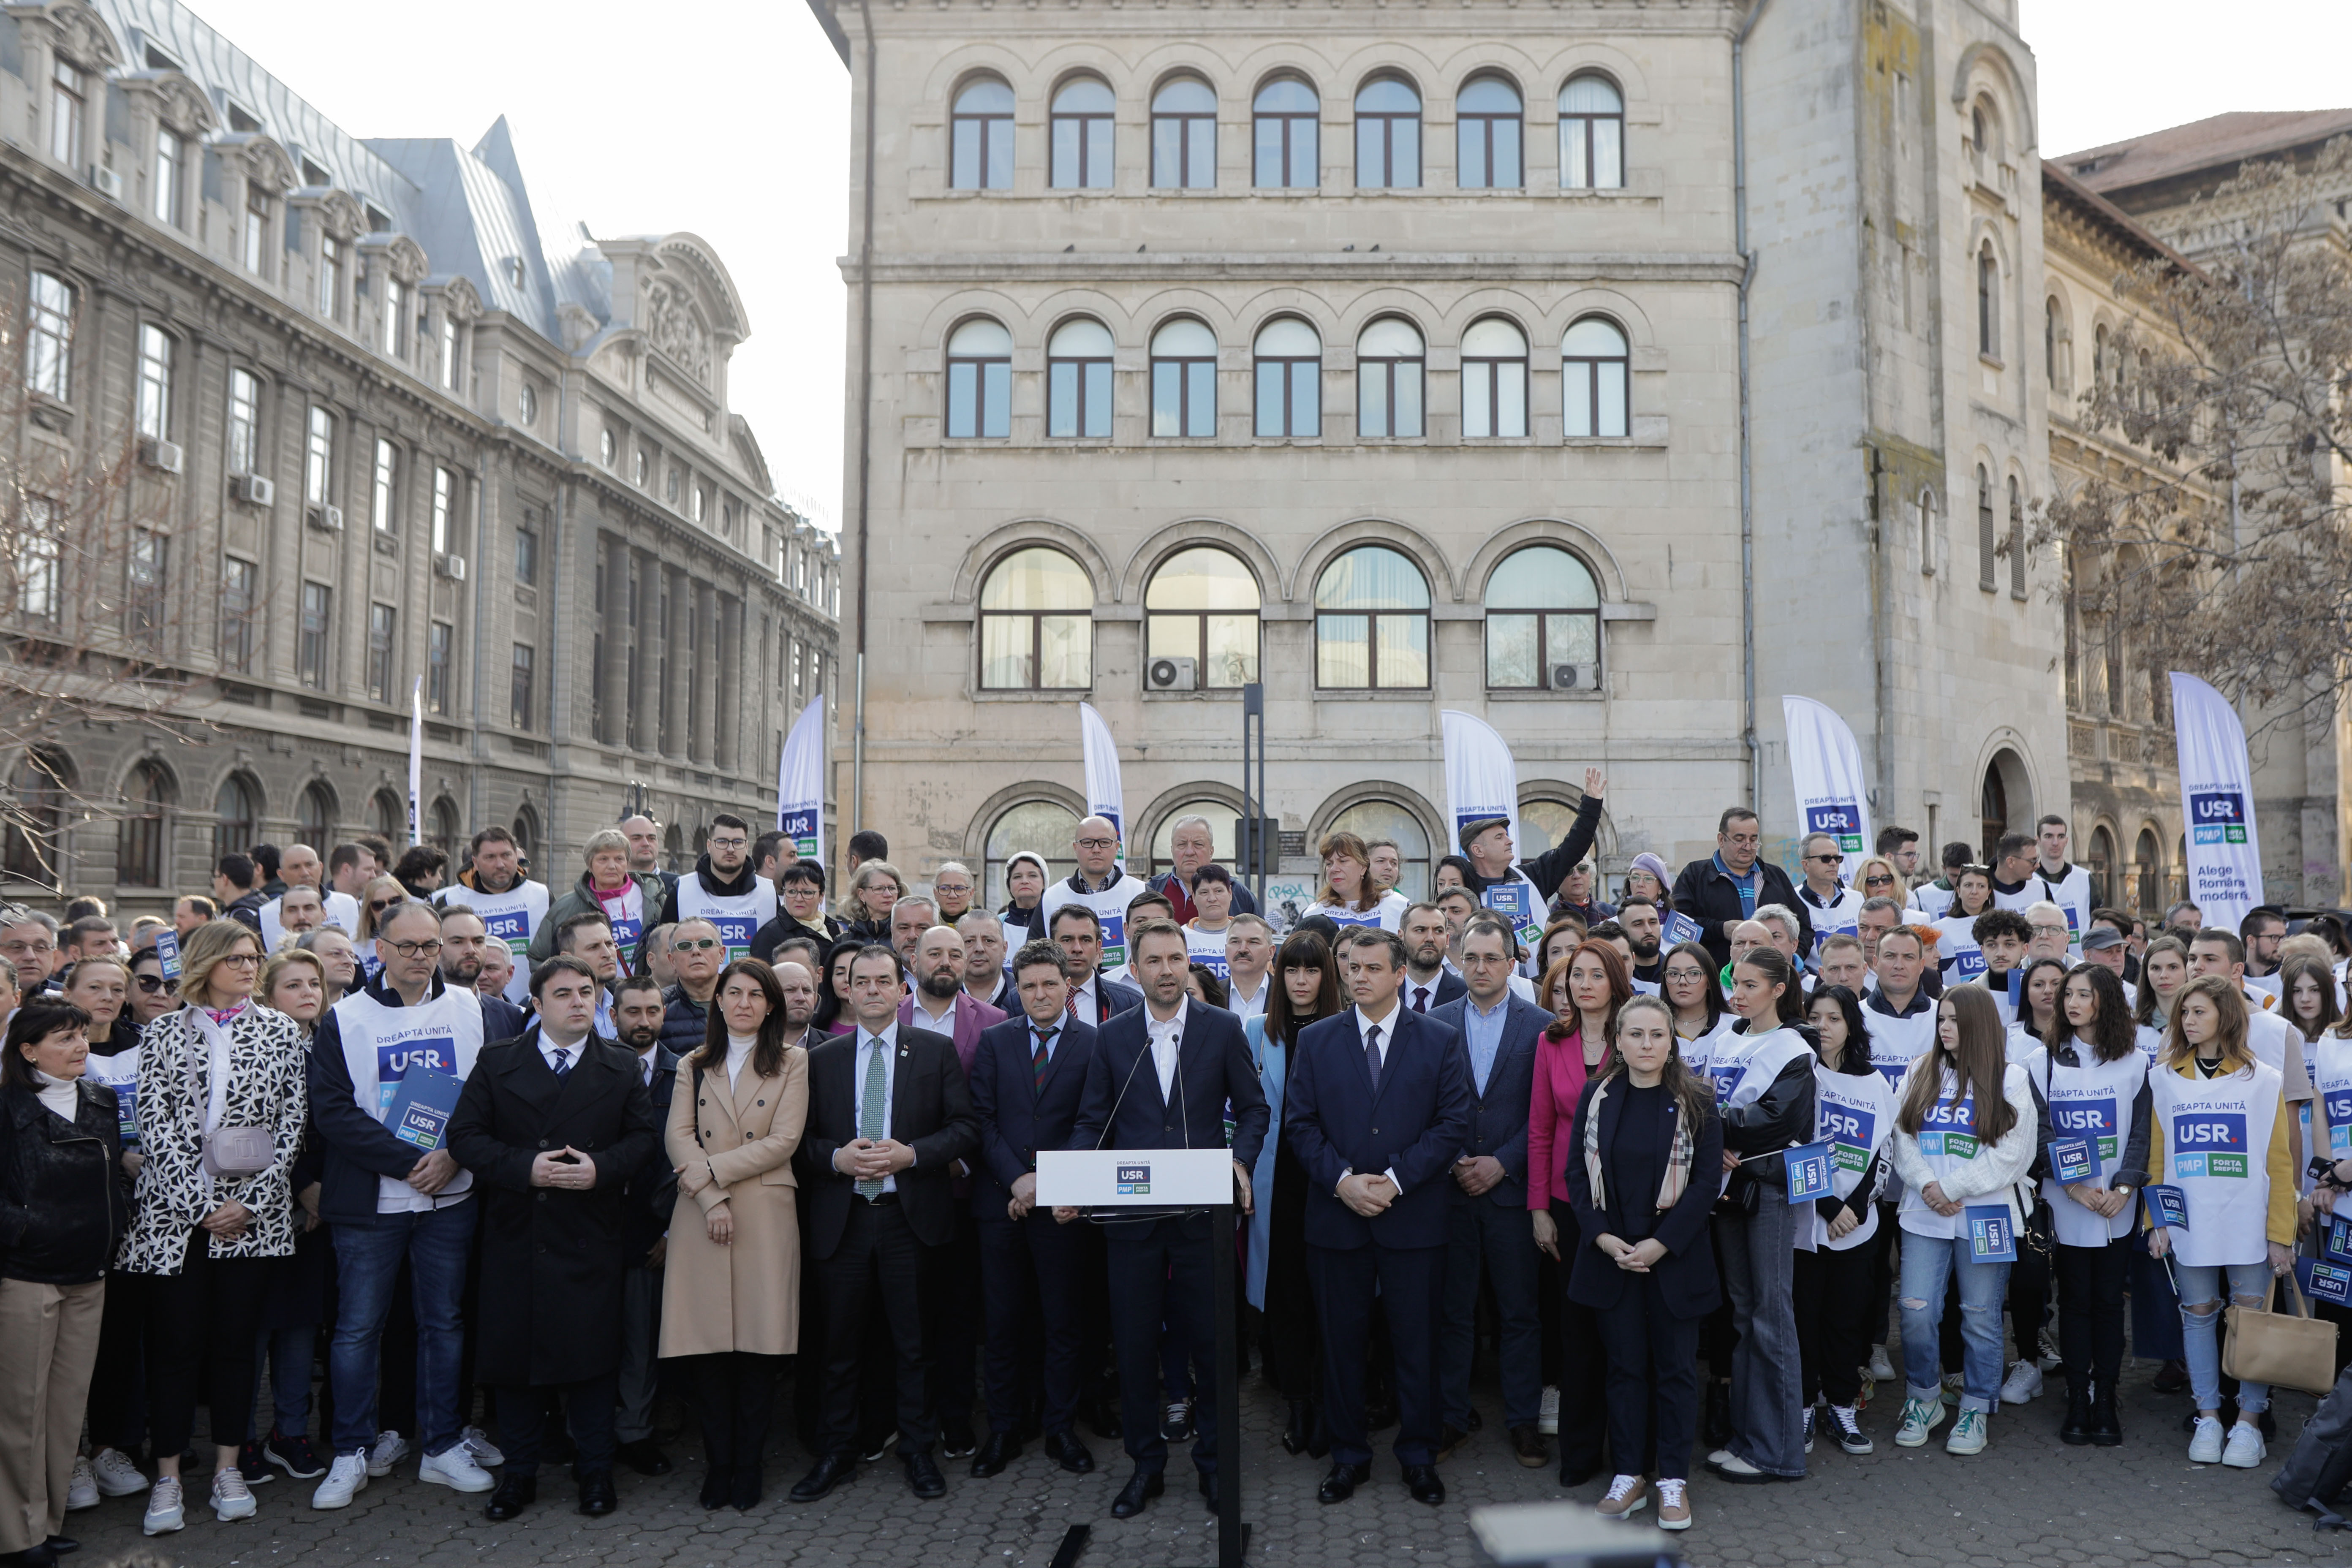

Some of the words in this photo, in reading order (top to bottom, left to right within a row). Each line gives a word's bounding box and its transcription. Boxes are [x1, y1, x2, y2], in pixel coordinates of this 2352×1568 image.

[2197, 829, 2221, 842] PMP
[2198, 864, 2232, 878] Alege
[473, 907, 504, 916] REAPTA
[1099, 907, 1122, 916] UNITĂ
[1360, 909, 1381, 919] UNITĂ
[612, 925, 638, 941] SR.
[377, 1028, 423, 1044] DREAPTA
[425, 1024, 453, 1035] UNITĂ
[2322, 1079, 2350, 1090] REAPTA
[2049, 1089, 2084, 1098] DREAPTA
[2086, 1085, 2115, 1097] UNITĂ
[410, 1100, 434, 1114] DREAPTA
[1849, 1097, 1876, 1111] UNITĂ
[2172, 1102, 2212, 1113] DREAPTA
[2215, 1100, 2246, 1110] UNITĂ
[2328, 1099, 2352, 1118] US
[2058, 1110, 2111, 1129] USR.
[400, 1129, 416, 1139] PMP
[2180, 1123, 2238, 1144] USR.
[1922, 1139, 1940, 1150] PMP
[2062, 1169, 2075, 1177] PMP
[2177, 1160, 2203, 1173] PMP
[1121, 1170, 1147, 1180] USR.
